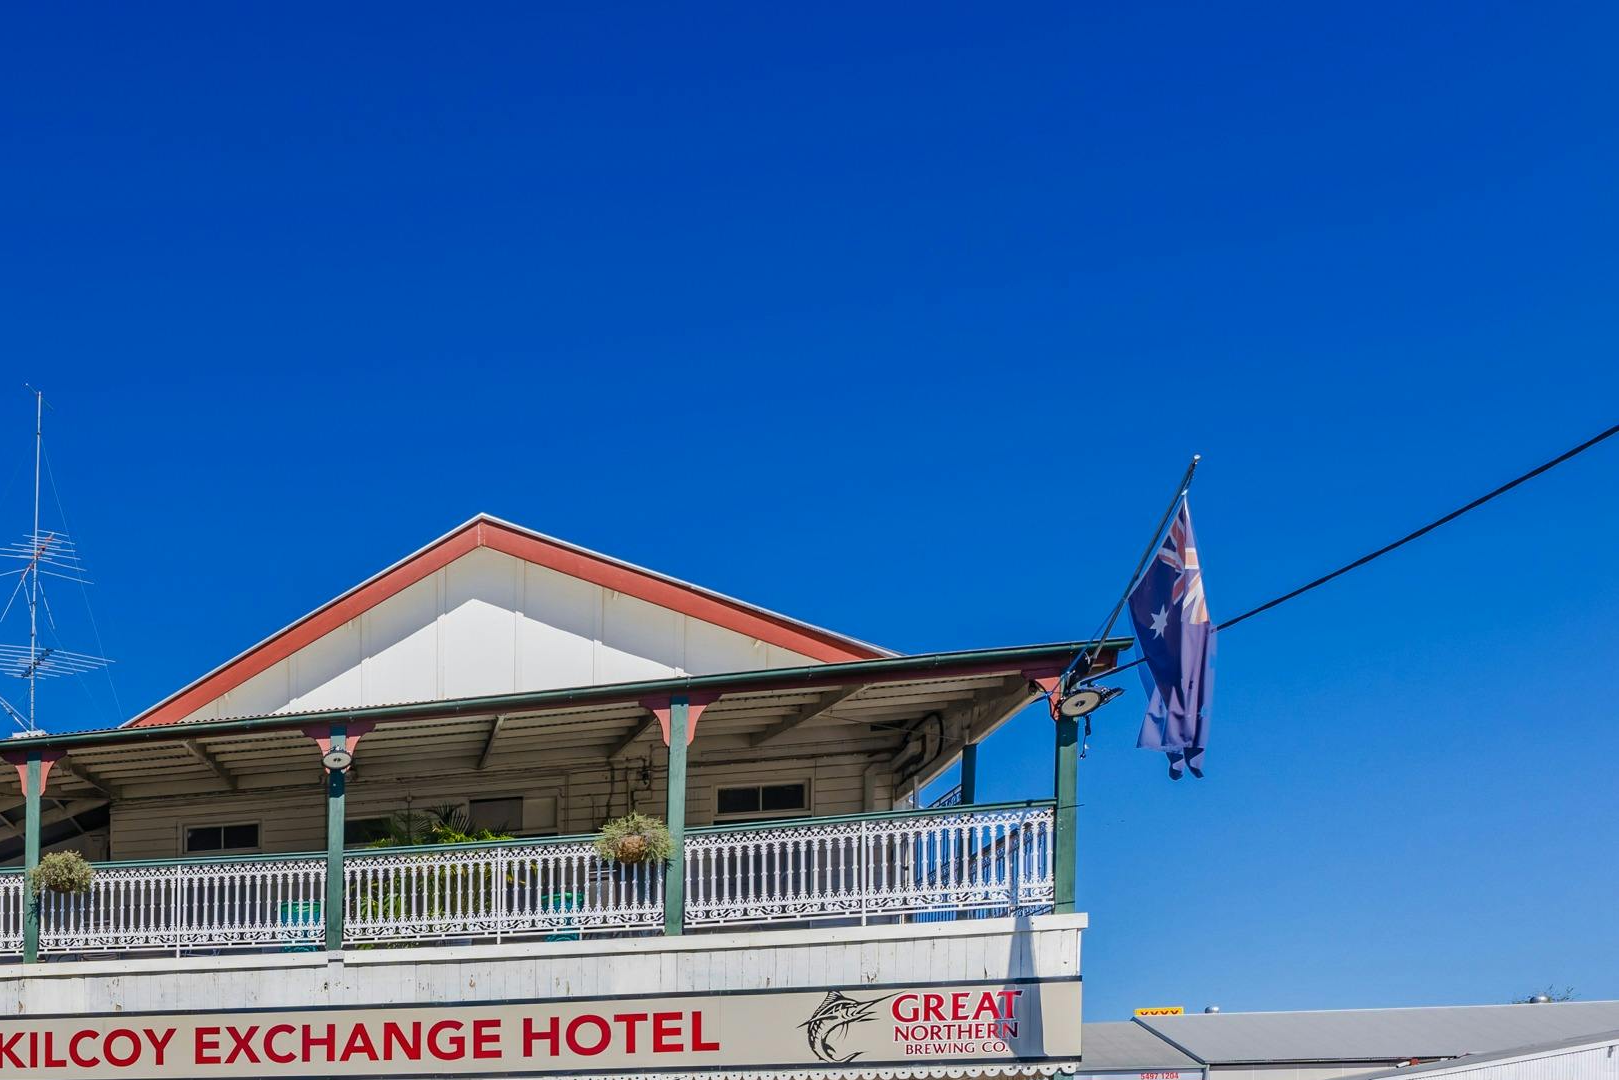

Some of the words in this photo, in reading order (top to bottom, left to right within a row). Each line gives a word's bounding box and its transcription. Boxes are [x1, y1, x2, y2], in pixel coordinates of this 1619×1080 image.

[891, 990, 1023, 1023] GREAT
[194, 1019, 503, 1065] EXCHANGE
[522, 1010, 721, 1058] HOTEL
[894, 1021, 1019, 1042] NORTHERN
[905, 1042, 975, 1055] BREWING
[981, 1041, 1009, 1053] CO.
[1140, 1073, 1159, 1080] 5497
[1161, 1072, 1180, 1080] 1204
